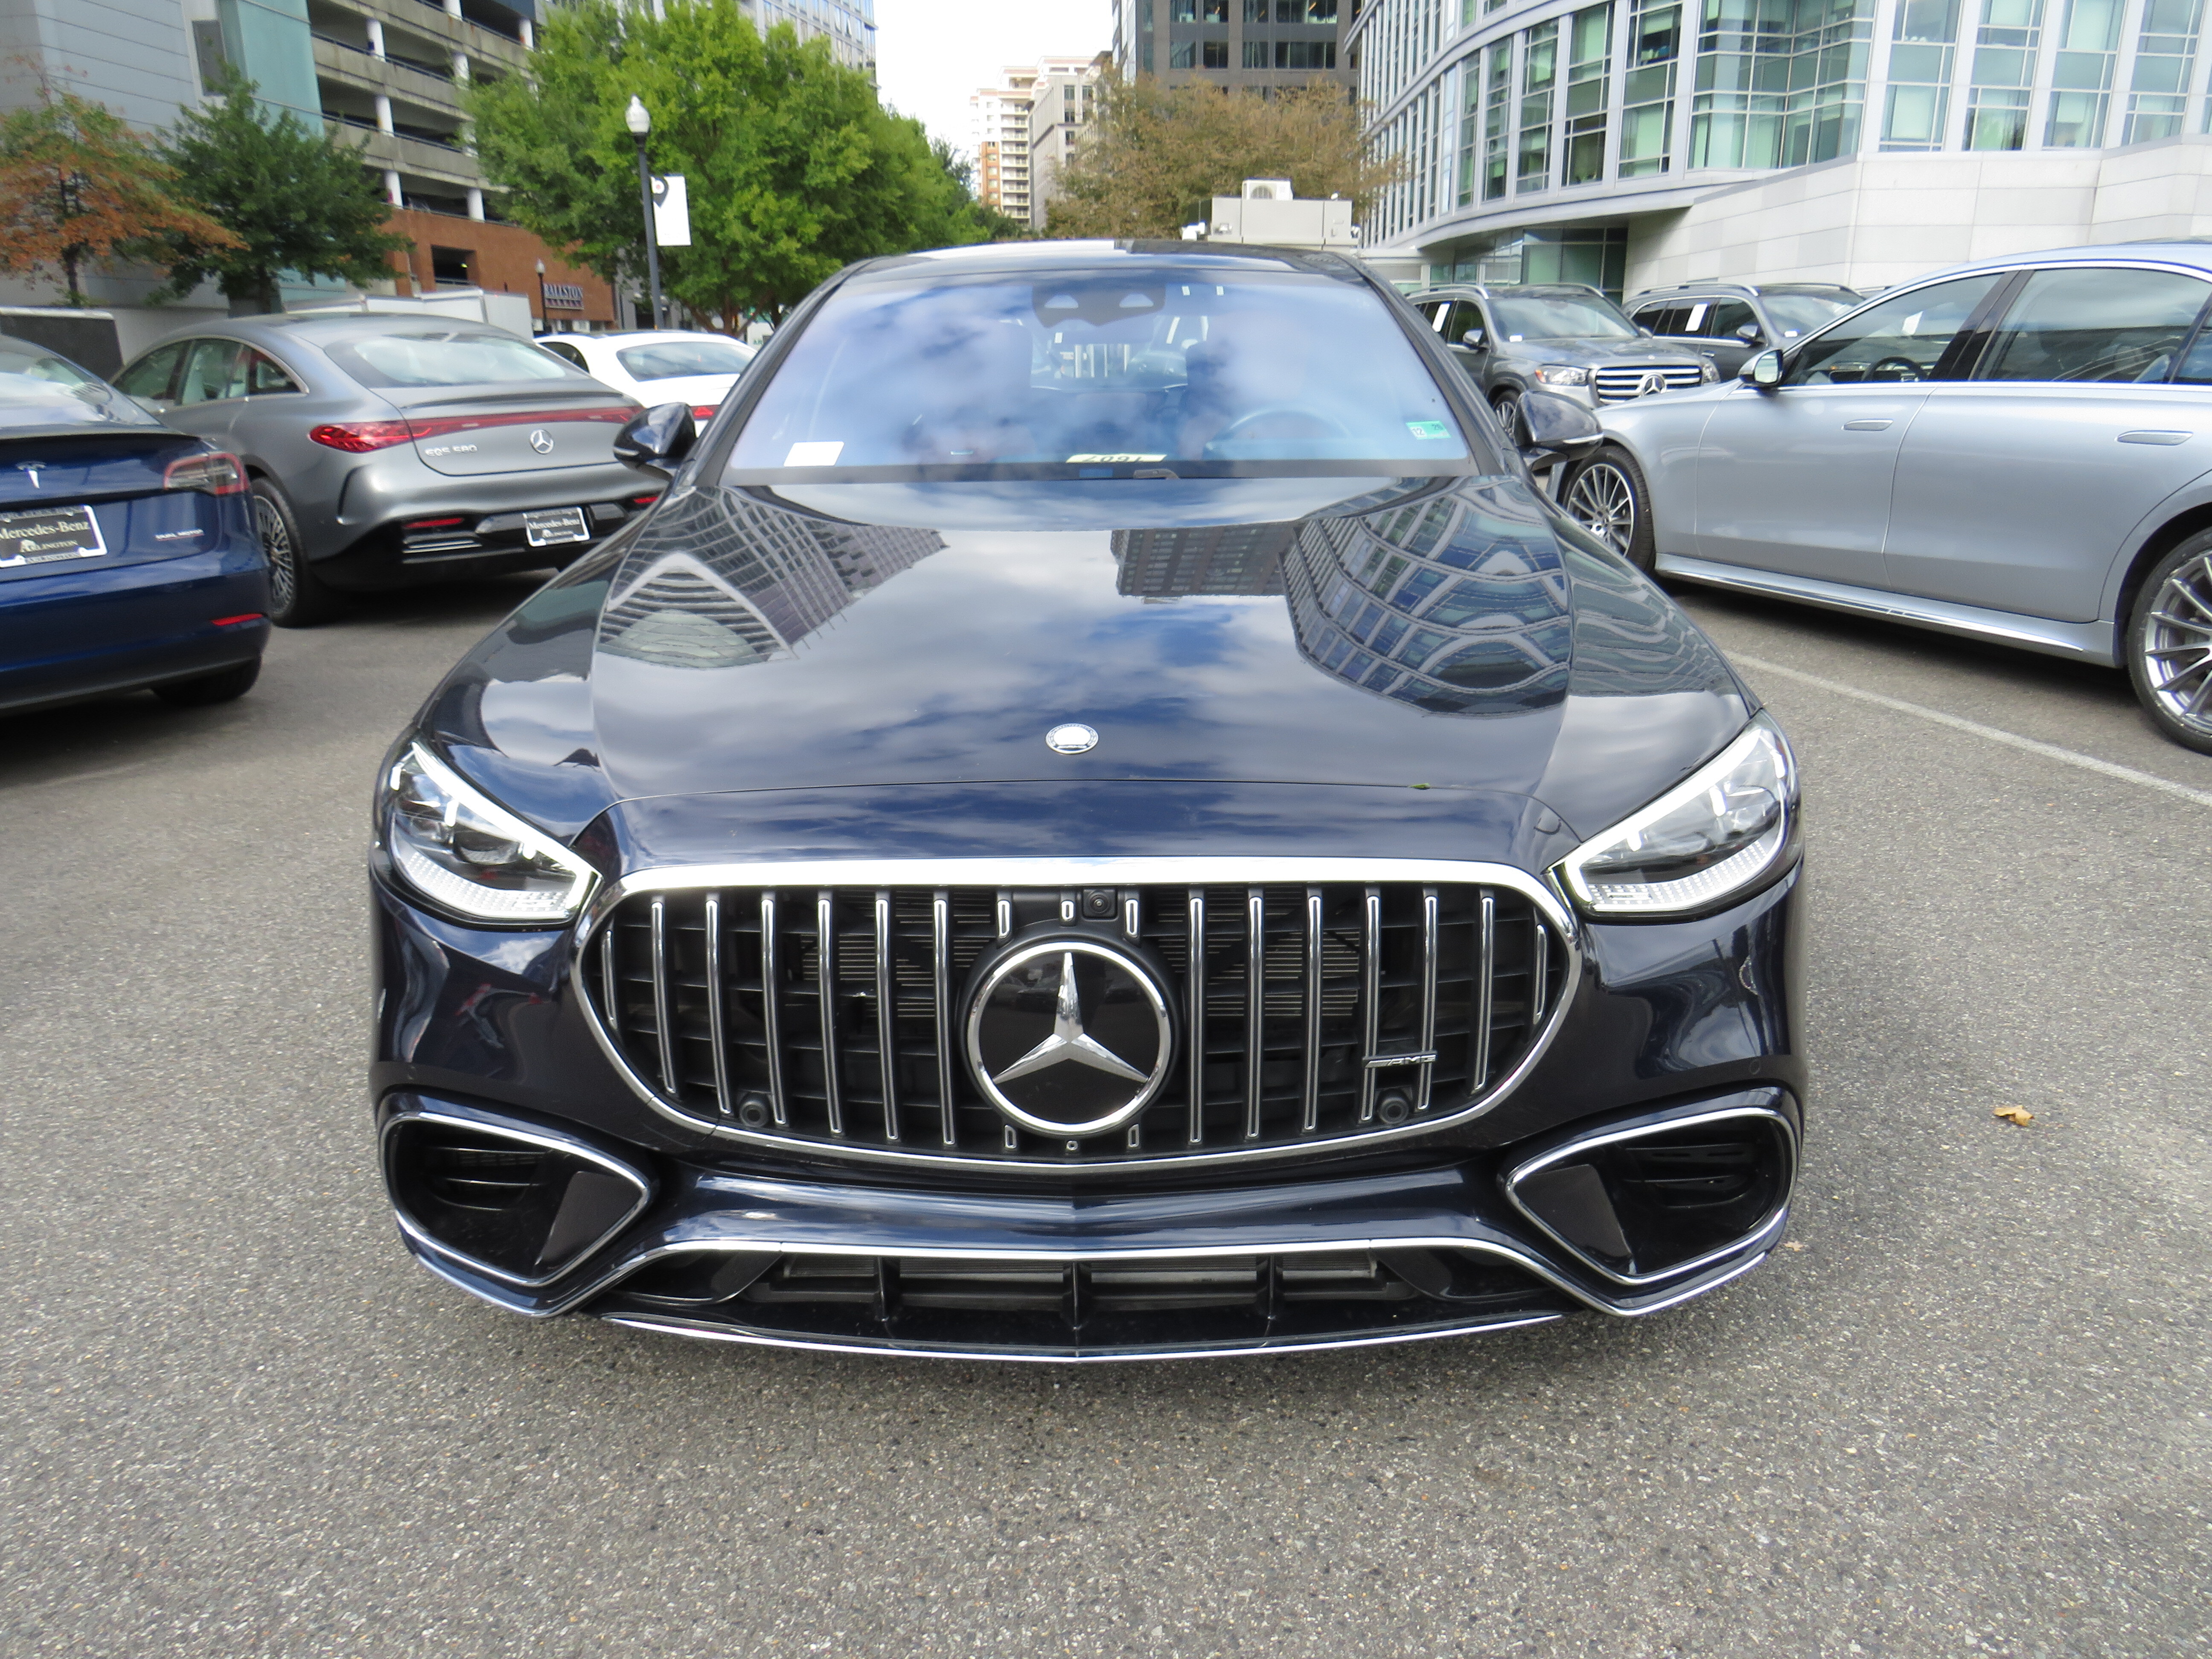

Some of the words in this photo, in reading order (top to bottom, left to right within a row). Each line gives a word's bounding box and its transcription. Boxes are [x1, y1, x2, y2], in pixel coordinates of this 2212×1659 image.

[425, 447, 451, 457] EQS
[452, 444, 477, 454] 580
[528, 518, 580, 530] Mercedes-Benz
[1388, 1055, 1436, 1066] AMG
